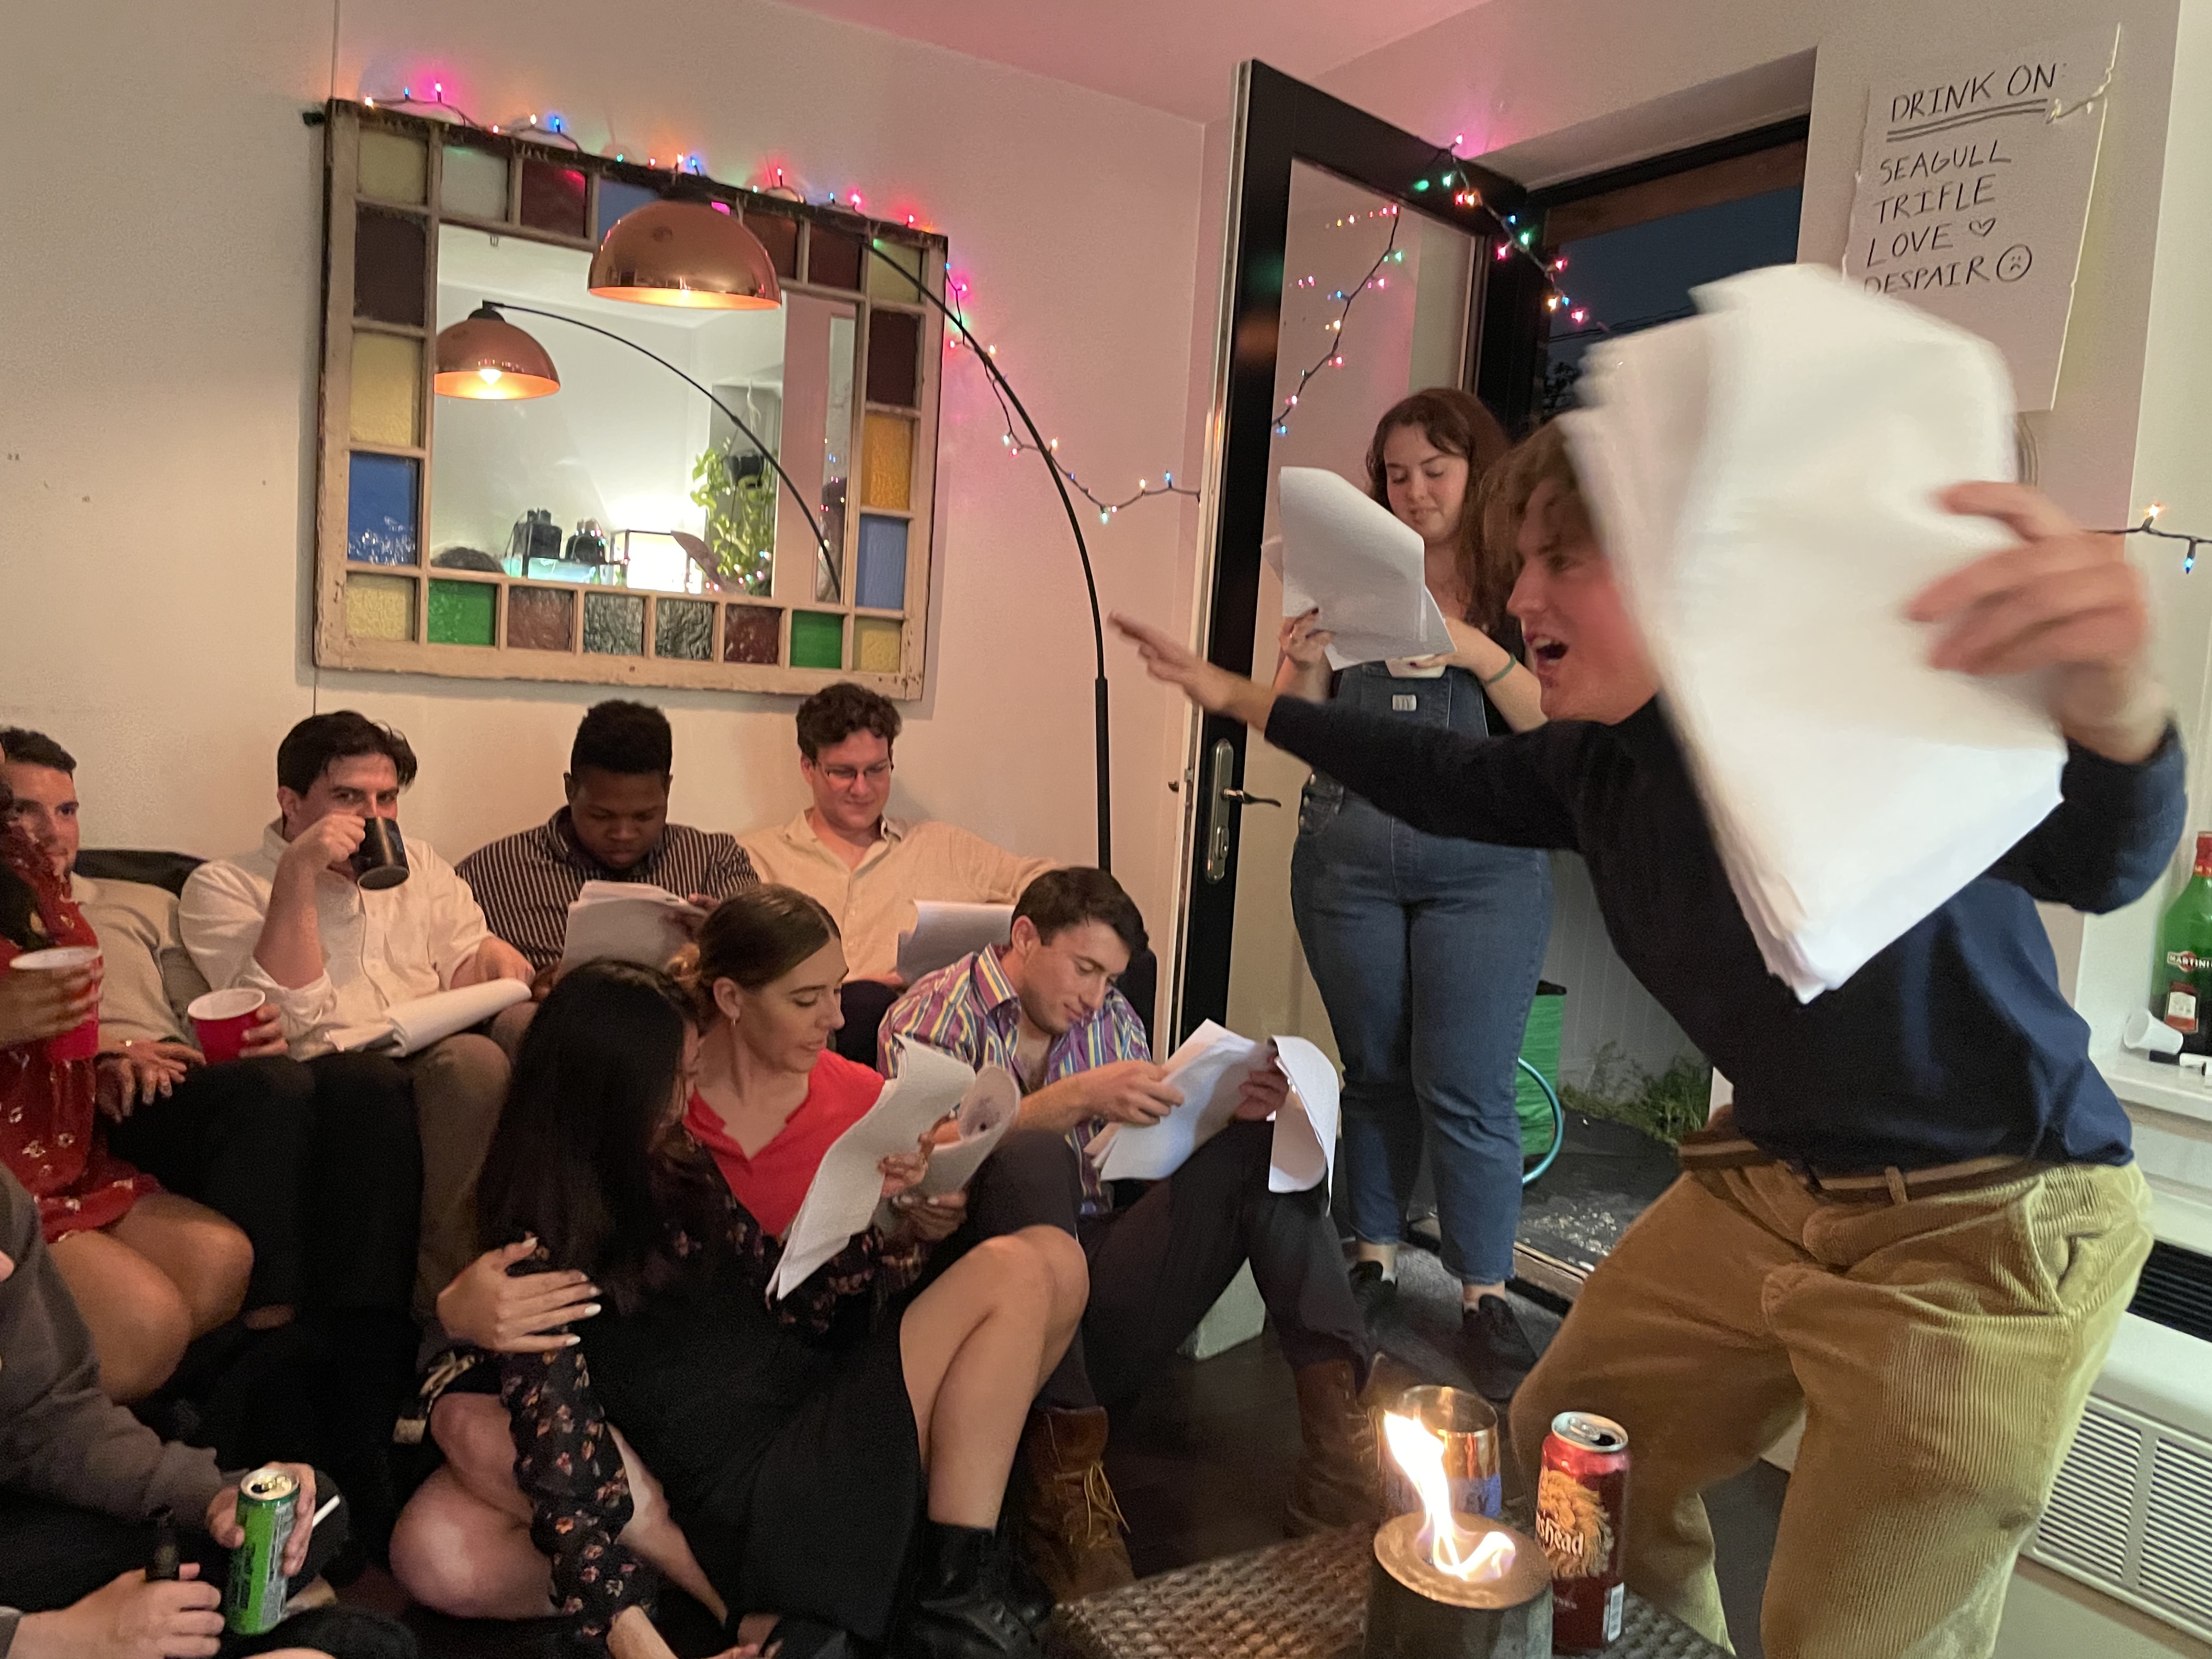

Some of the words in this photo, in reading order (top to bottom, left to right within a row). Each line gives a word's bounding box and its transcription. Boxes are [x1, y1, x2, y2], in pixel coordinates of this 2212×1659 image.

[1891, 71, 1996, 122] DRINK
[1880, 140, 2011, 185] SEAGULL
[1874, 174, 1996, 224] TRIFLE
[1867, 223, 1954, 268] LOVE
[1864, 256, 1990, 294] DESPAIR
[2170, 955, 2209, 968] MARTINI
